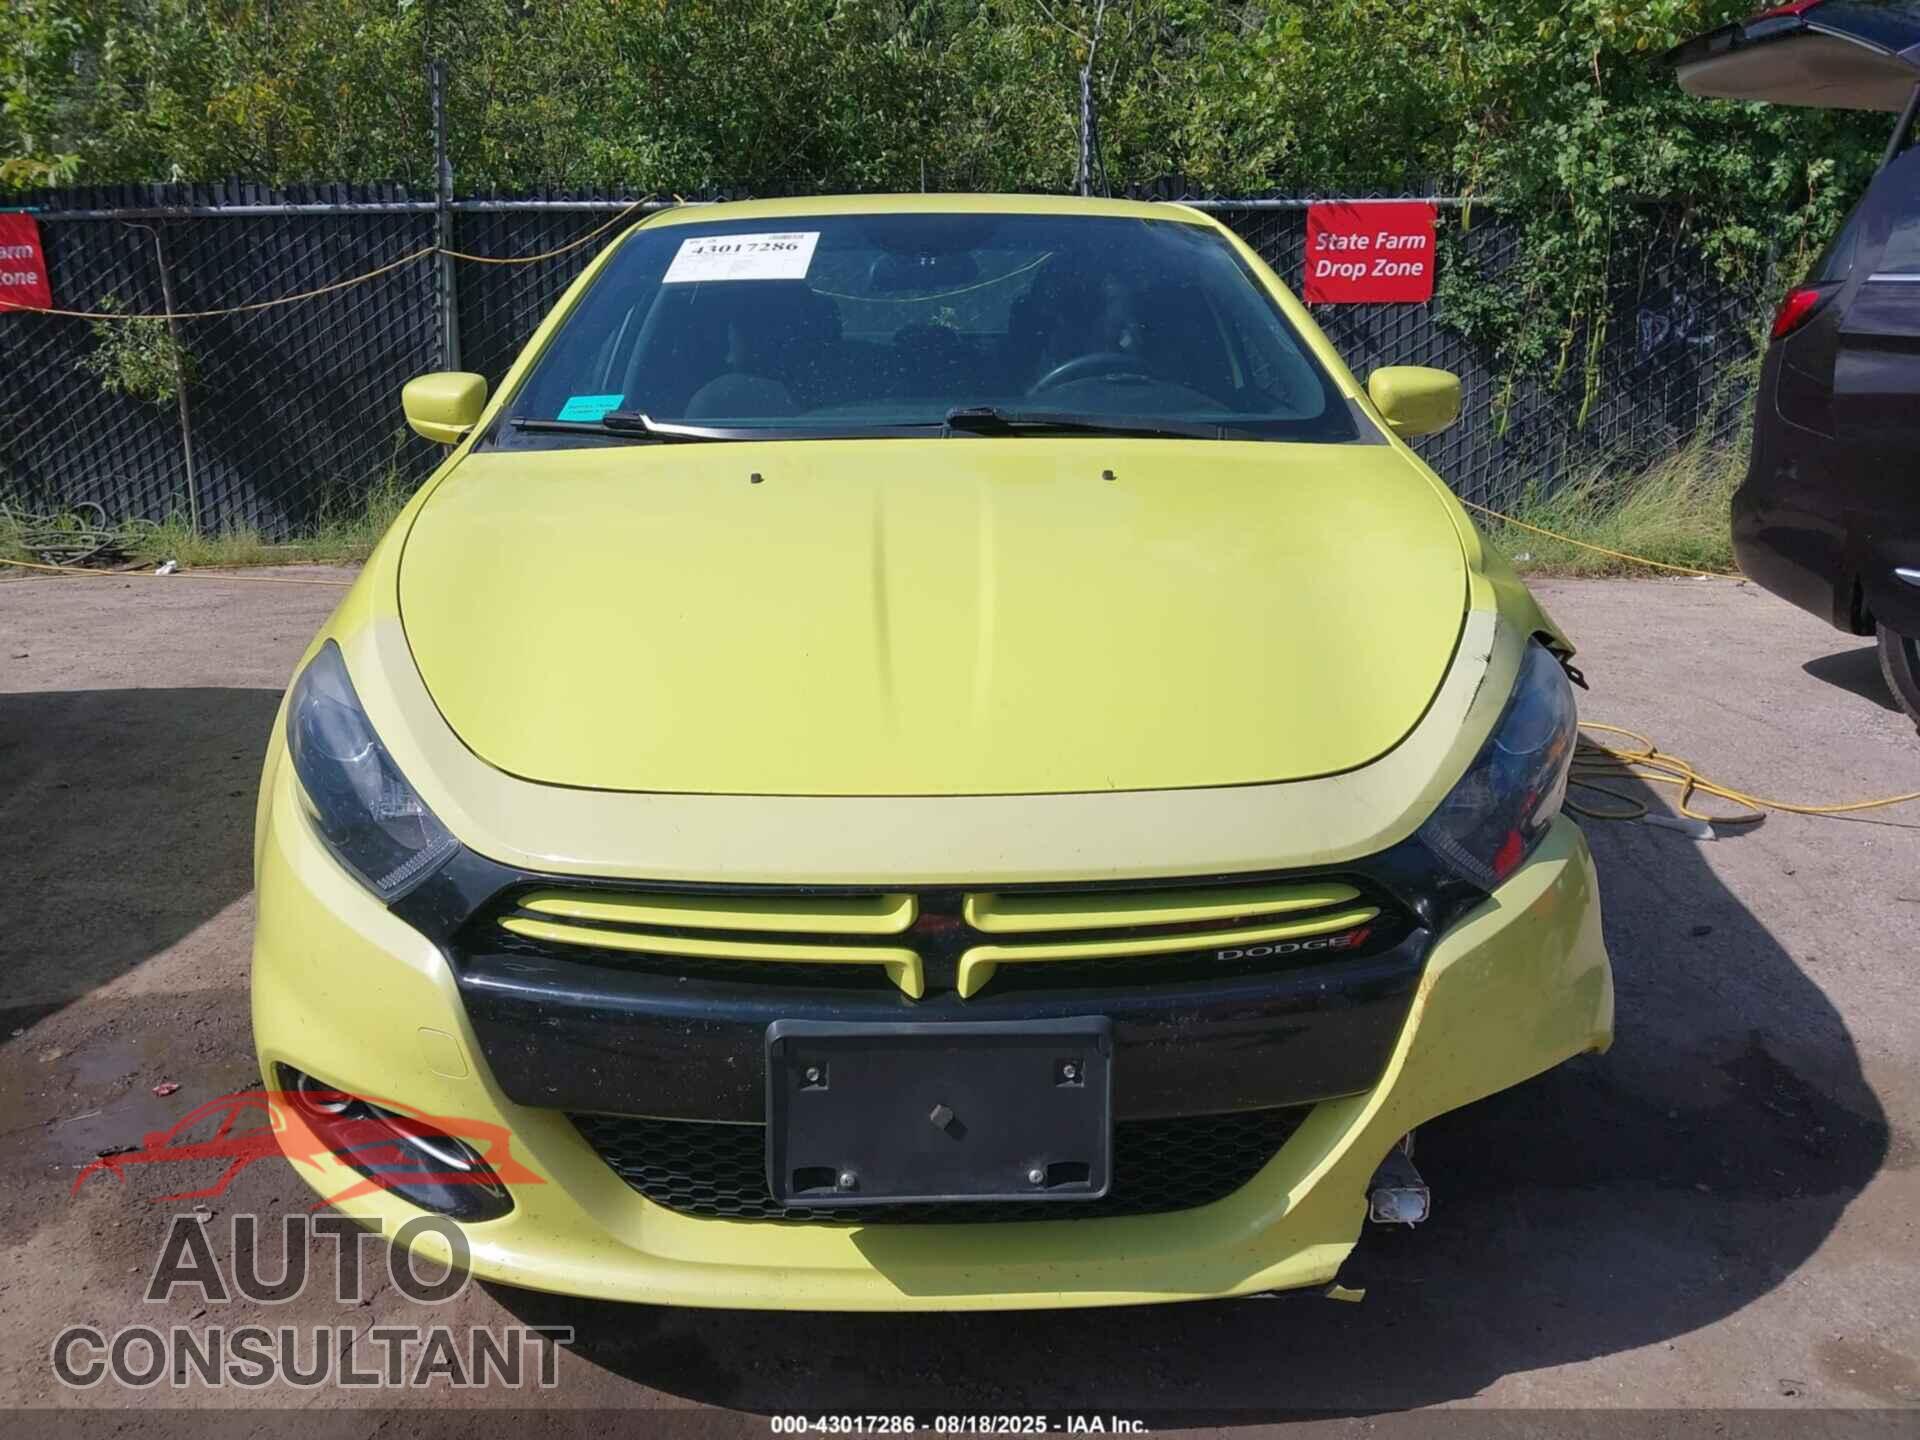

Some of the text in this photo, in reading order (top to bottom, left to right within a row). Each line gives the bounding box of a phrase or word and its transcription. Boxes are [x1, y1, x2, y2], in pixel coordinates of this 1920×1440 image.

[691, 242, 799, 255] 43017286
[1315, 231, 1426, 250] State Farm
[0, 245, 33, 259] arm
[0, 270, 37, 285] one
[1315, 258, 1423, 281] Drop Zone
[1217, 936, 1351, 961] DODGE
